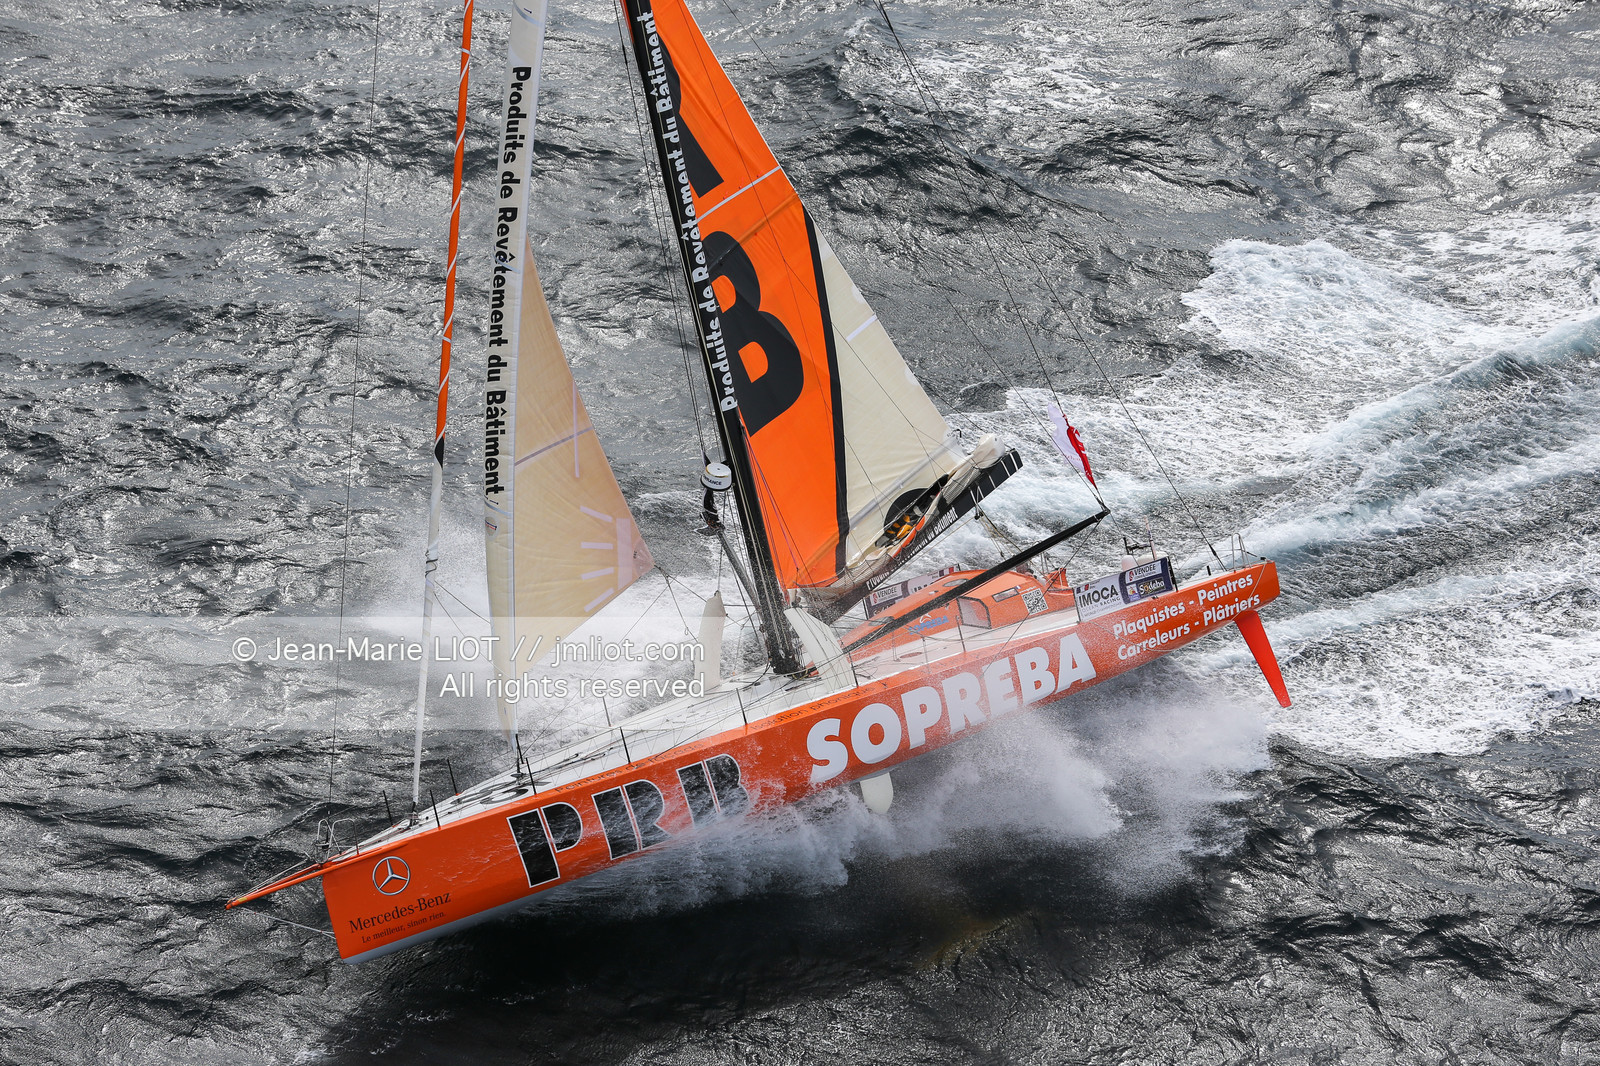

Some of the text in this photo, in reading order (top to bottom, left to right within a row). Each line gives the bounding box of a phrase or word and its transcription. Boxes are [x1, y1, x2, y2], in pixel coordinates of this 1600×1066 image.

[637, 11, 738, 412] Produits de Revêtement du Bâtiment
[485, 66, 532, 496] Produits de Revêtement du Bâtiment
[1078, 585, 1119, 608] IMOCA
[1100, 597, 1121, 606] RACING
[1113, 599, 1186, 641] Plaquistes
[1197, 573, 1254, 606] Peintres
[1140, 580, 1165, 596] Sodebo
[1117, 622, 1191, 661] Carreleurs
[1203, 592, 1261, 627] Plâtriers
[806, 632, 1097, 784] SOPREBA
[506, 753, 751, 888] PRB
[348, 892, 452, 933] Mercedes-Benz
[361, 935, 372, 944] Le
[373, 924, 406, 940] meilleur,
[407, 917, 428, 928] sinon
